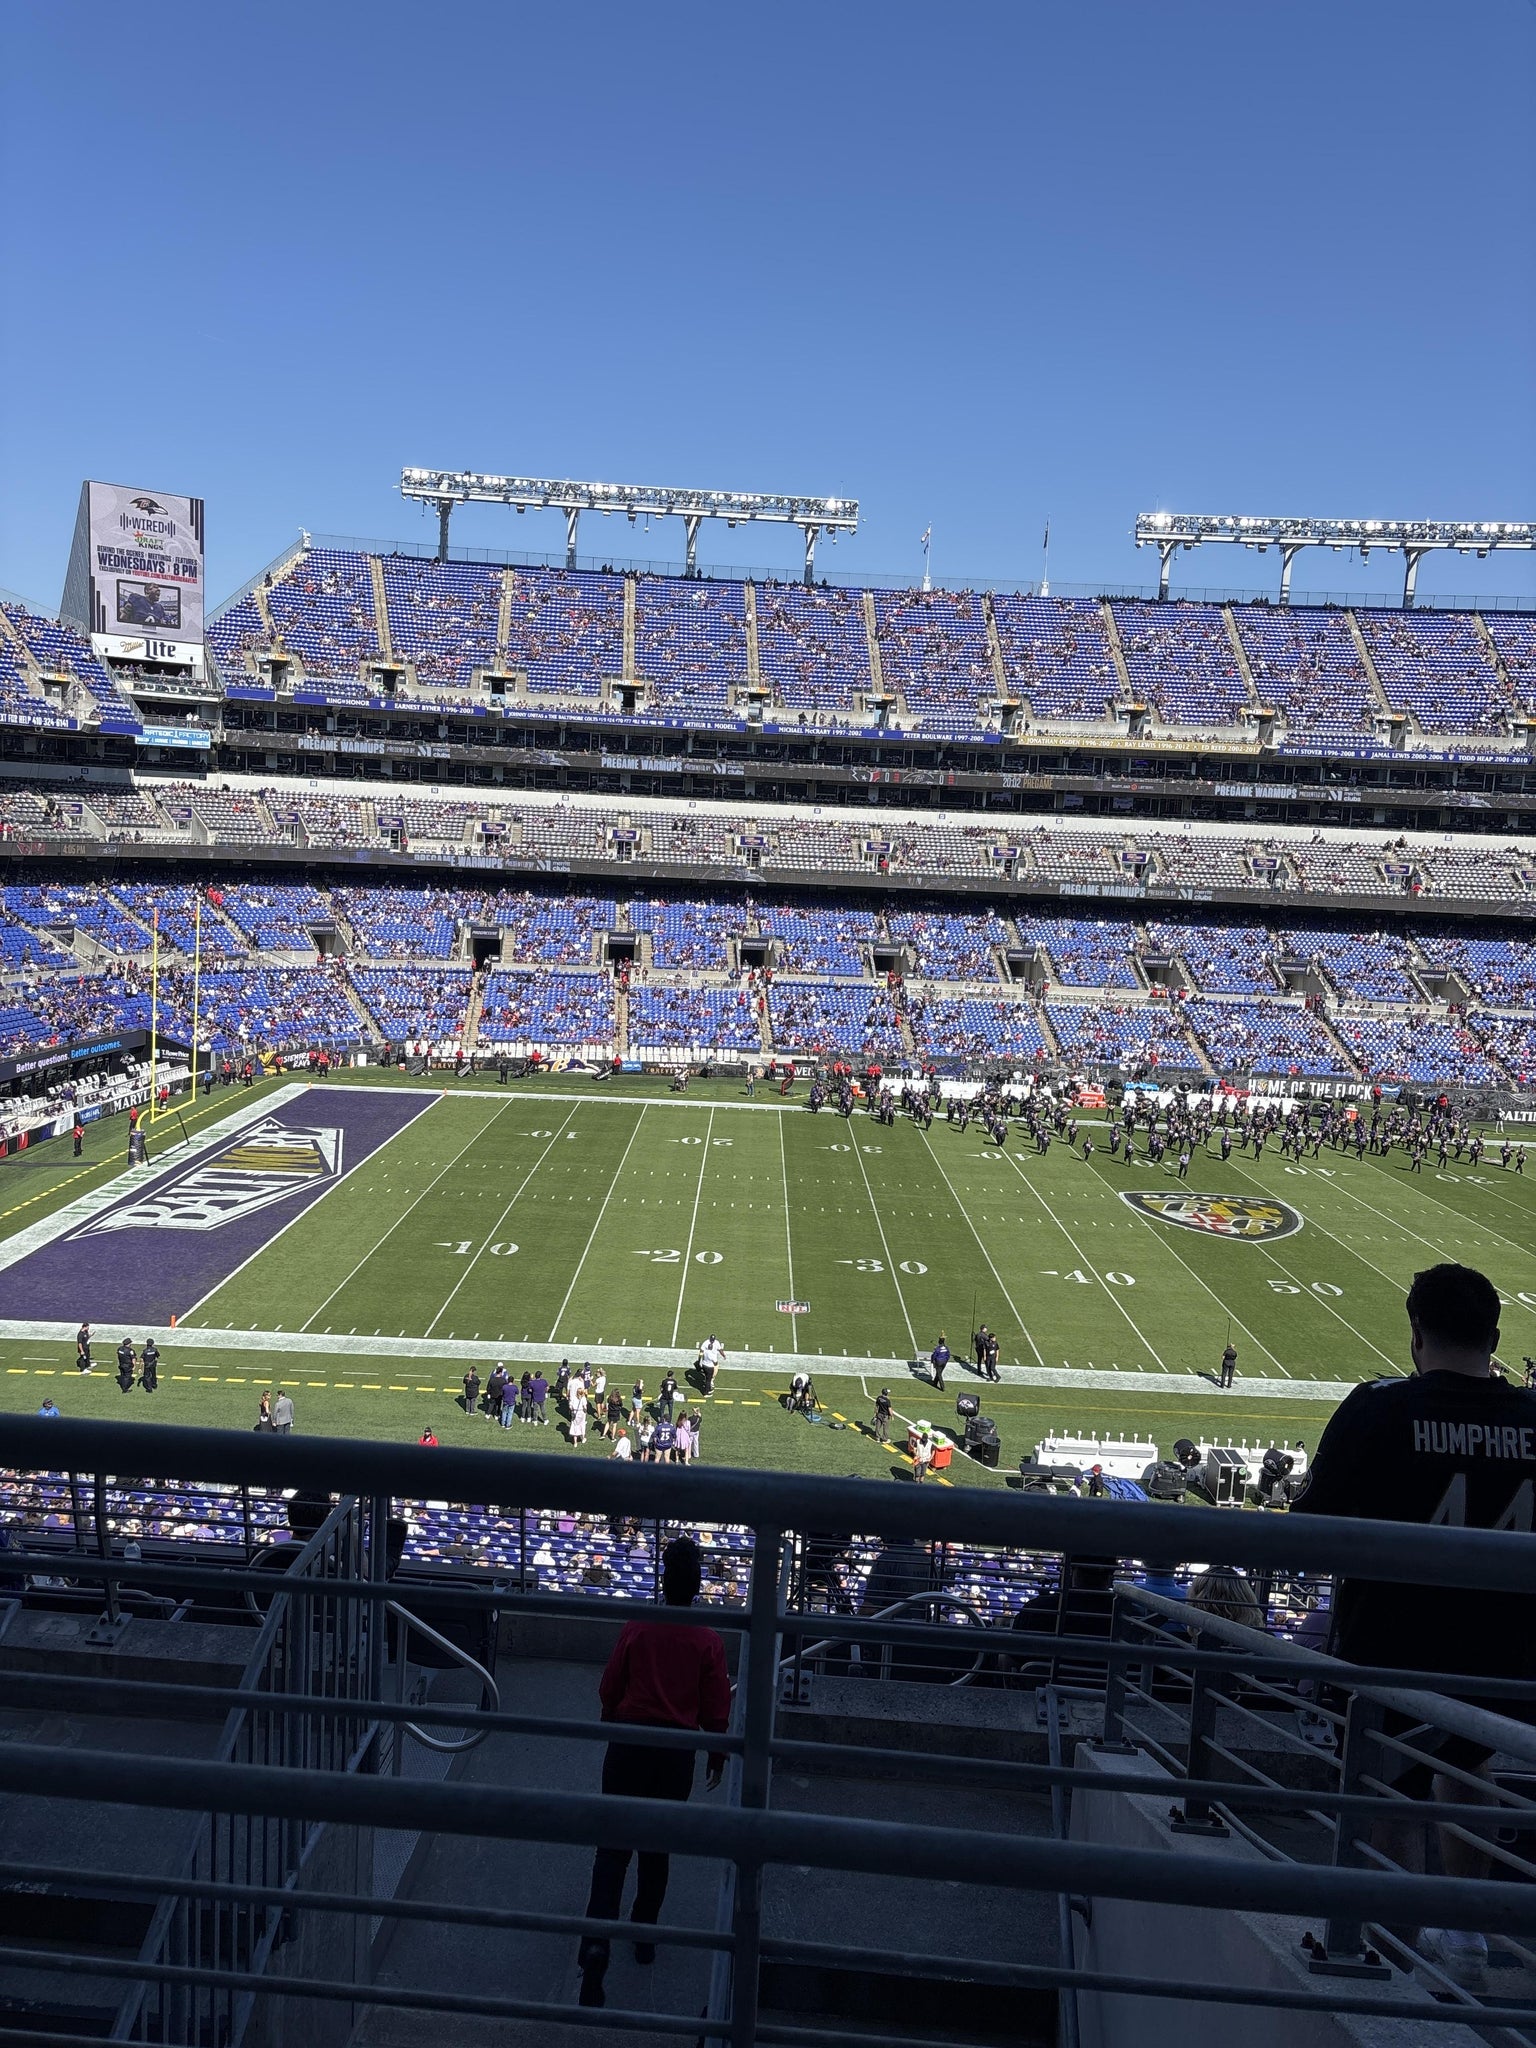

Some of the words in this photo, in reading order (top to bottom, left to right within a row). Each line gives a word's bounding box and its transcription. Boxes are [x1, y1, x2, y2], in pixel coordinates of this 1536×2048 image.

[131, 517, 164, 533] WIRED
[126, 549, 144, 558] SCENES
[97, 552, 165, 573] WEDNESDAYS
[173, 563, 180, 576] 8
[182, 565, 198, 578] PM
[120, 641, 144, 653] Miller
[394, 703, 421, 711] EARNEST
[442, 706, 474, 714] 1996-2003
[682, 721, 706, 729] ARTHUR
[778, 726, 803, 734] MICHAEL
[832, 729, 862, 737] 1997-2002
[903, 732, 920, 740] PETER
[954, 734, 985, 742] 1997-2005
[1026, 736, 1058, 745] JONATHAN
[1081, 739, 1114, 747] 1996-2007
[297, 738, 338, 751] PREGAME
[340, 740, 385, 754] WARMUPS
[1136, 741, 1157, 749] LEWIS
[1158, 742, 1190, 750] 1996-2012
[1283, 747, 1299, 755] MATT
[1300, 748, 1324, 756] STOVER
[1324, 749, 1355, 757] 1996-2008
[1371, 751, 1391, 759] JAMAL
[1391, 752, 1410, 760] LEWIS
[1410, 753, 1444, 761] 2000-2006
[1458, 754, 1476, 762] TODD
[1494, 755, 1528, 764] 2001-2010
[601, 757, 640, 770] PREGAME
[641, 758, 682, 772] WARMUPS
[1003, 777, 1021, 788] 20:02
[1023, 778, 1053, 789] PREGAME
[1215, 785, 1253, 796] PREGAME
[1255, 786, 1297, 799] WARMUPS
[62, 844, 76, 854] 4:05
[77, 845, 86, 855] PM
[458, 855, 503, 869] WARMUPS
[1059, 884, 1100, 896] PREGAME
[1101, 885, 1146, 898] WARMUPS
[16, 1061, 37, 1073] Better
[38, 1053, 70, 1069] questions.
[70, 1048, 89, 1060] Better
[90, 1040, 122, 1054] outcomes.
[1309, 1082, 1333, 1099] THE
[92, 1124, 334, 1228] BALTIMORE
[88, 1169, 159, 1199] TAKES
[1137, 1193, 1267, 1206] RAVENS
[650, 1249, 724, 1265] 20
[856, 1258, 928, 1275] 30
[1064, 1269, 1136, 1287] 40
[1267, 1279, 1344, 1297] 50
[660, 1432, 670, 1441] 25
